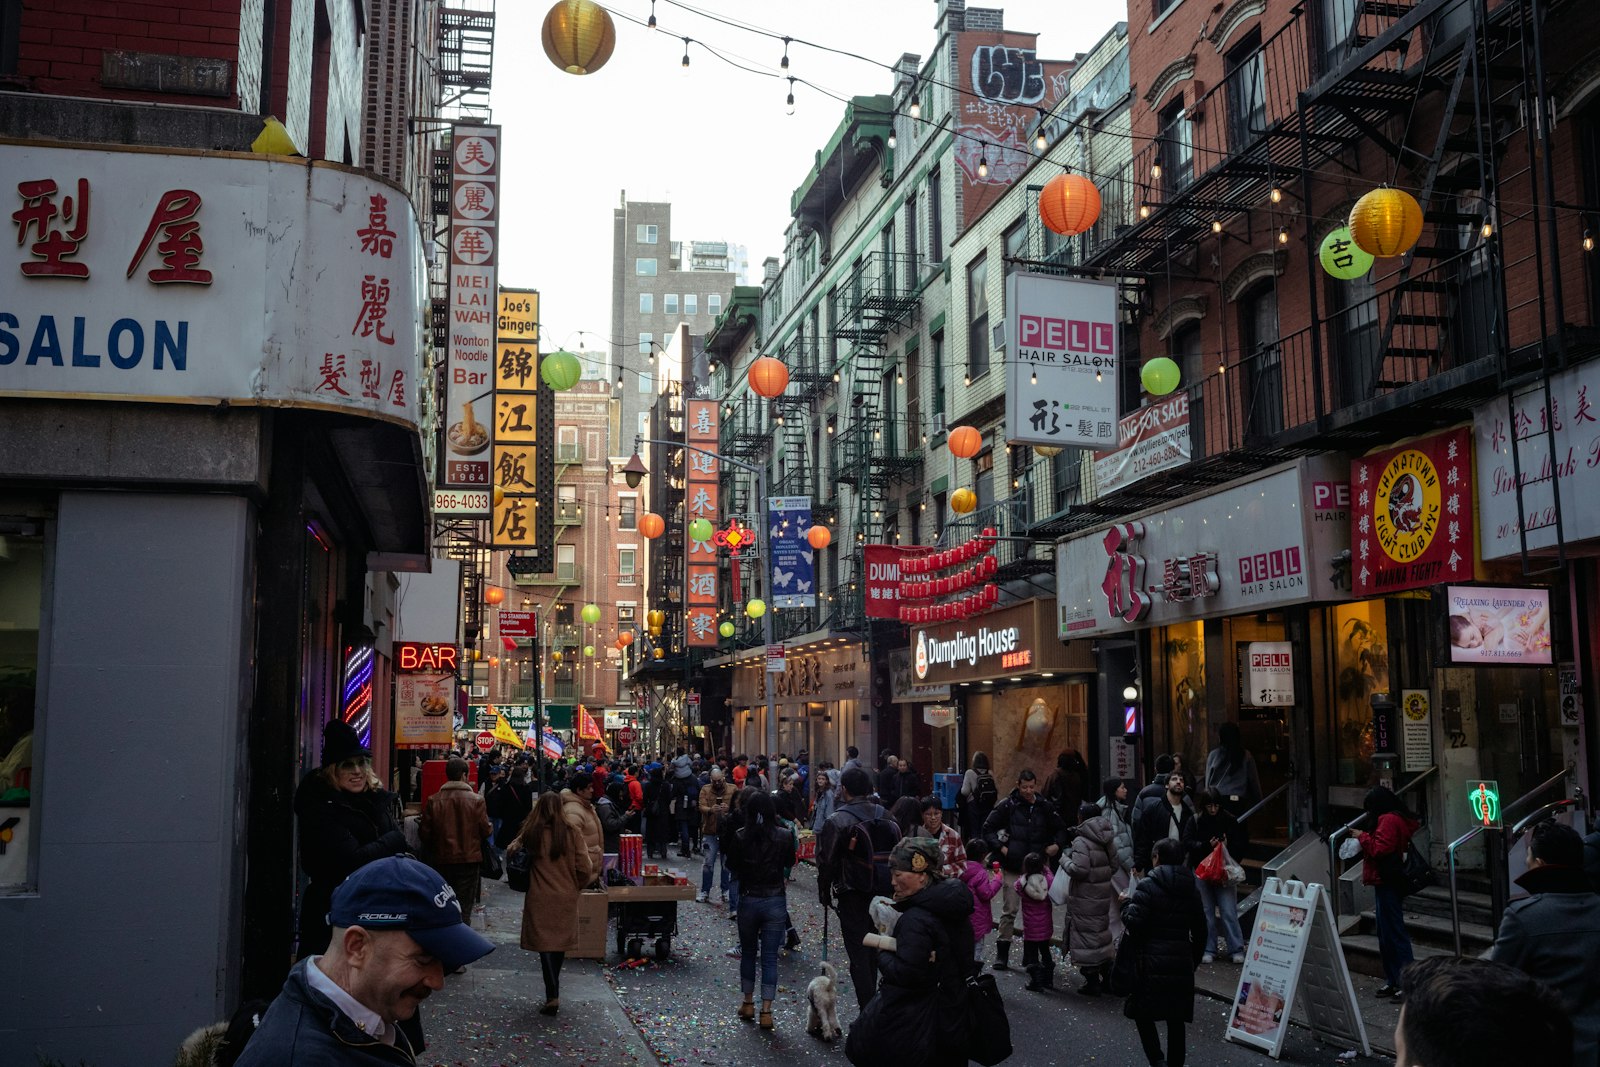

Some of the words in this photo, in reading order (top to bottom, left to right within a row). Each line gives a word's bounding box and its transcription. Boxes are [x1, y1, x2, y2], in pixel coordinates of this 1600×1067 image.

[458, 140, 492, 262] 美麗華
[11, 177, 213, 286] 型屋
[1329, 238, 1354, 269] 吉
[456, 275, 489, 288] MEI
[458, 293, 487, 306] LAI
[503, 297, 531, 312] Joe's
[455, 310, 490, 324] WAH
[498, 316, 537, 334] Ginger
[0, 312, 189, 371] SALON
[453, 335, 489, 347] Wonton
[1021, 318, 1111, 351] PELL
[455, 349, 488, 361] Noodle
[1019, 349, 1056, 363] HAIR
[1062, 352, 1114, 368] SALON
[315, 352, 406, 408] 髮型屋
[453, 368, 488, 385] Bar
[1161, 396, 1189, 424] SALE
[495, 347, 536, 541] 錦江飯店
[455, 463, 482, 472] EST:
[1377, 453, 1437, 499] CHINATOWN
[451, 473, 485, 482] 1964
[436, 494, 488, 509] 966-4033
[1315, 512, 1347, 522] HAIR
[1496, 523, 1510, 539] 20
[1512, 511, 1538, 536] Pll
[1376, 515, 1399, 555] FIGHT
[1398, 536, 1426, 559] CLUB
[1423, 503, 1439, 537] NYC
[1240, 548, 1300, 584] PELL
[1374, 565, 1408, 588] WANNA
[1410, 560, 1444, 582] FIGHT?
[1242, 583, 1265, 597] HAIR
[1269, 575, 1303, 592] SALON
[928, 630, 976, 669] Dumpling
[978, 626, 1016, 657] House
[400, 646, 456, 670] BAR
[1252, 654, 1290, 667] PELL
[477, 736, 494, 745] STOP
[620, 731, 636, 740] STOP
[1378, 714, 1388, 749] CLUB
[1450, 732, 1468, 749] 22
[357, 912, 408, 921] ROGUE
